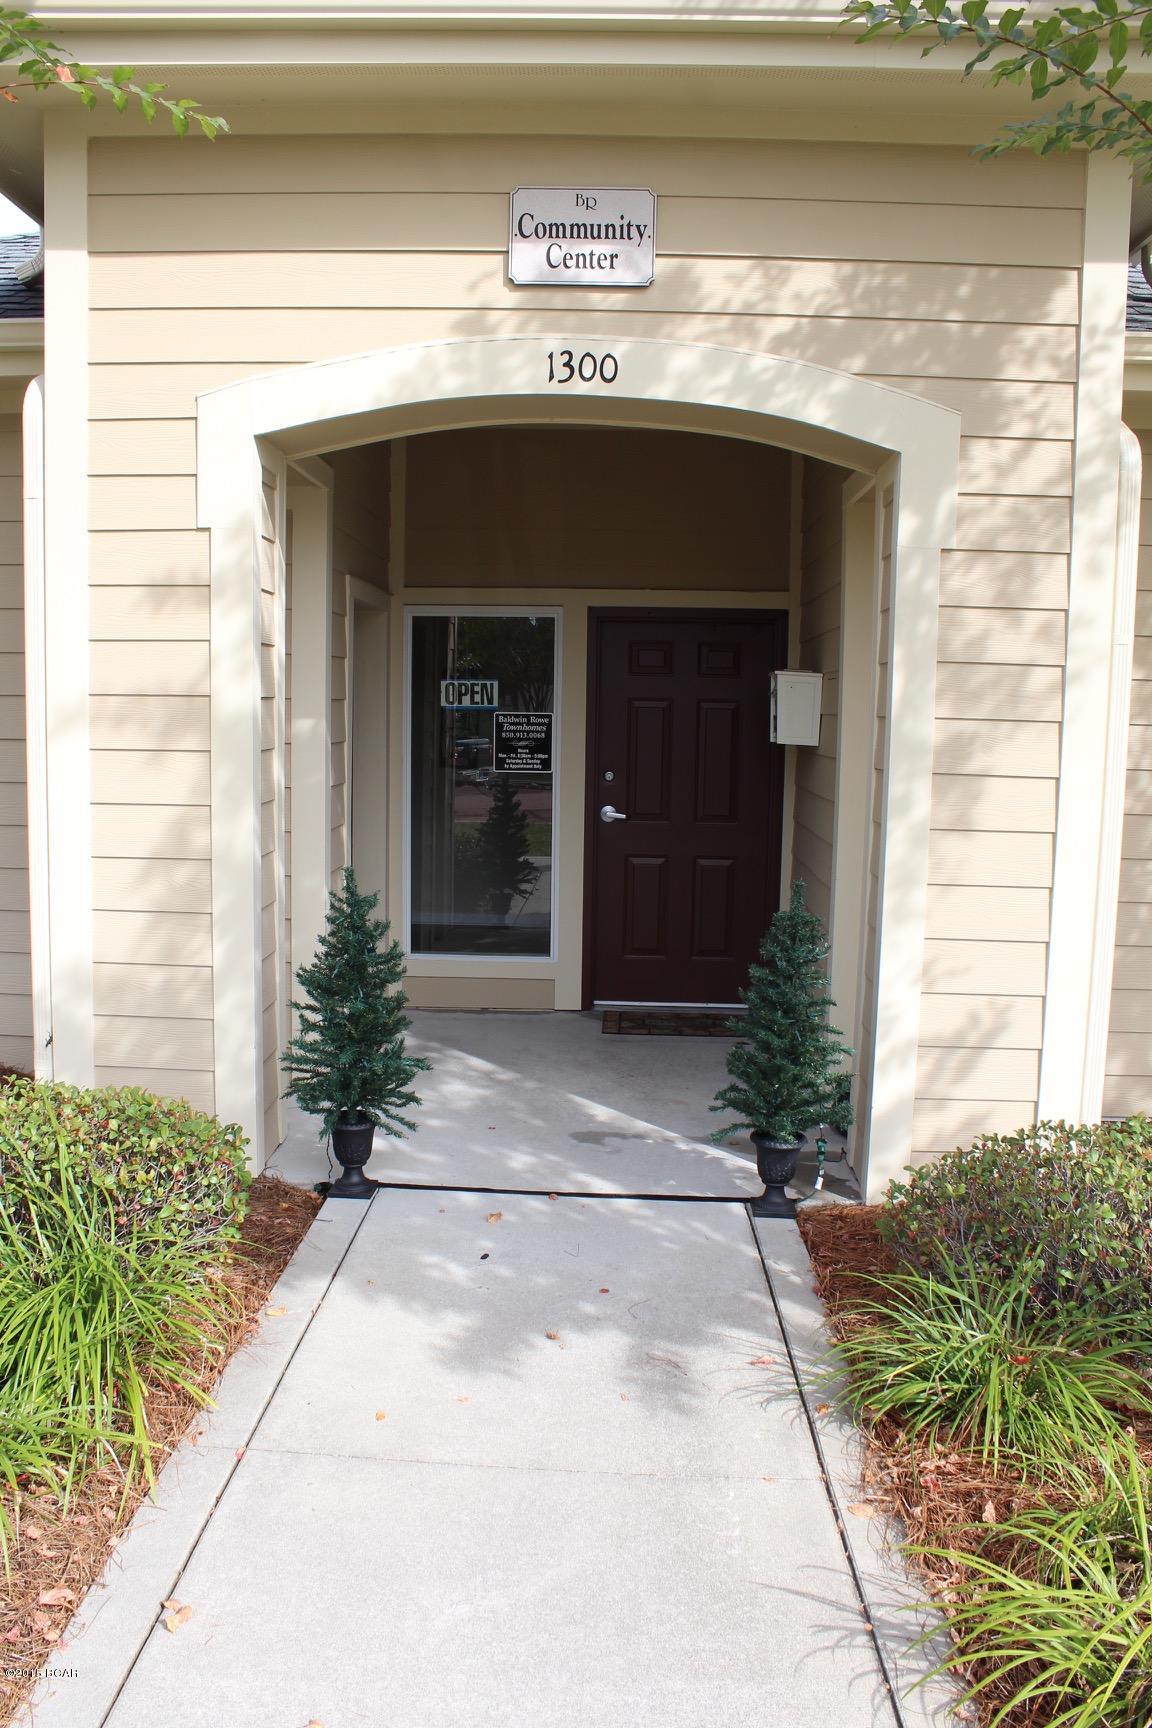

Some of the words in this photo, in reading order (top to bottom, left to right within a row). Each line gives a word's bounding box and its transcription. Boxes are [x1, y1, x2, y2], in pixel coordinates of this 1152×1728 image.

[517, 212, 648, 247] Community
[546, 242, 619, 270] Center
[547, 349, 619, 383] 1300
[445, 681, 494, 705] OPEN
[503, 723, 547, 731] Townhomes
